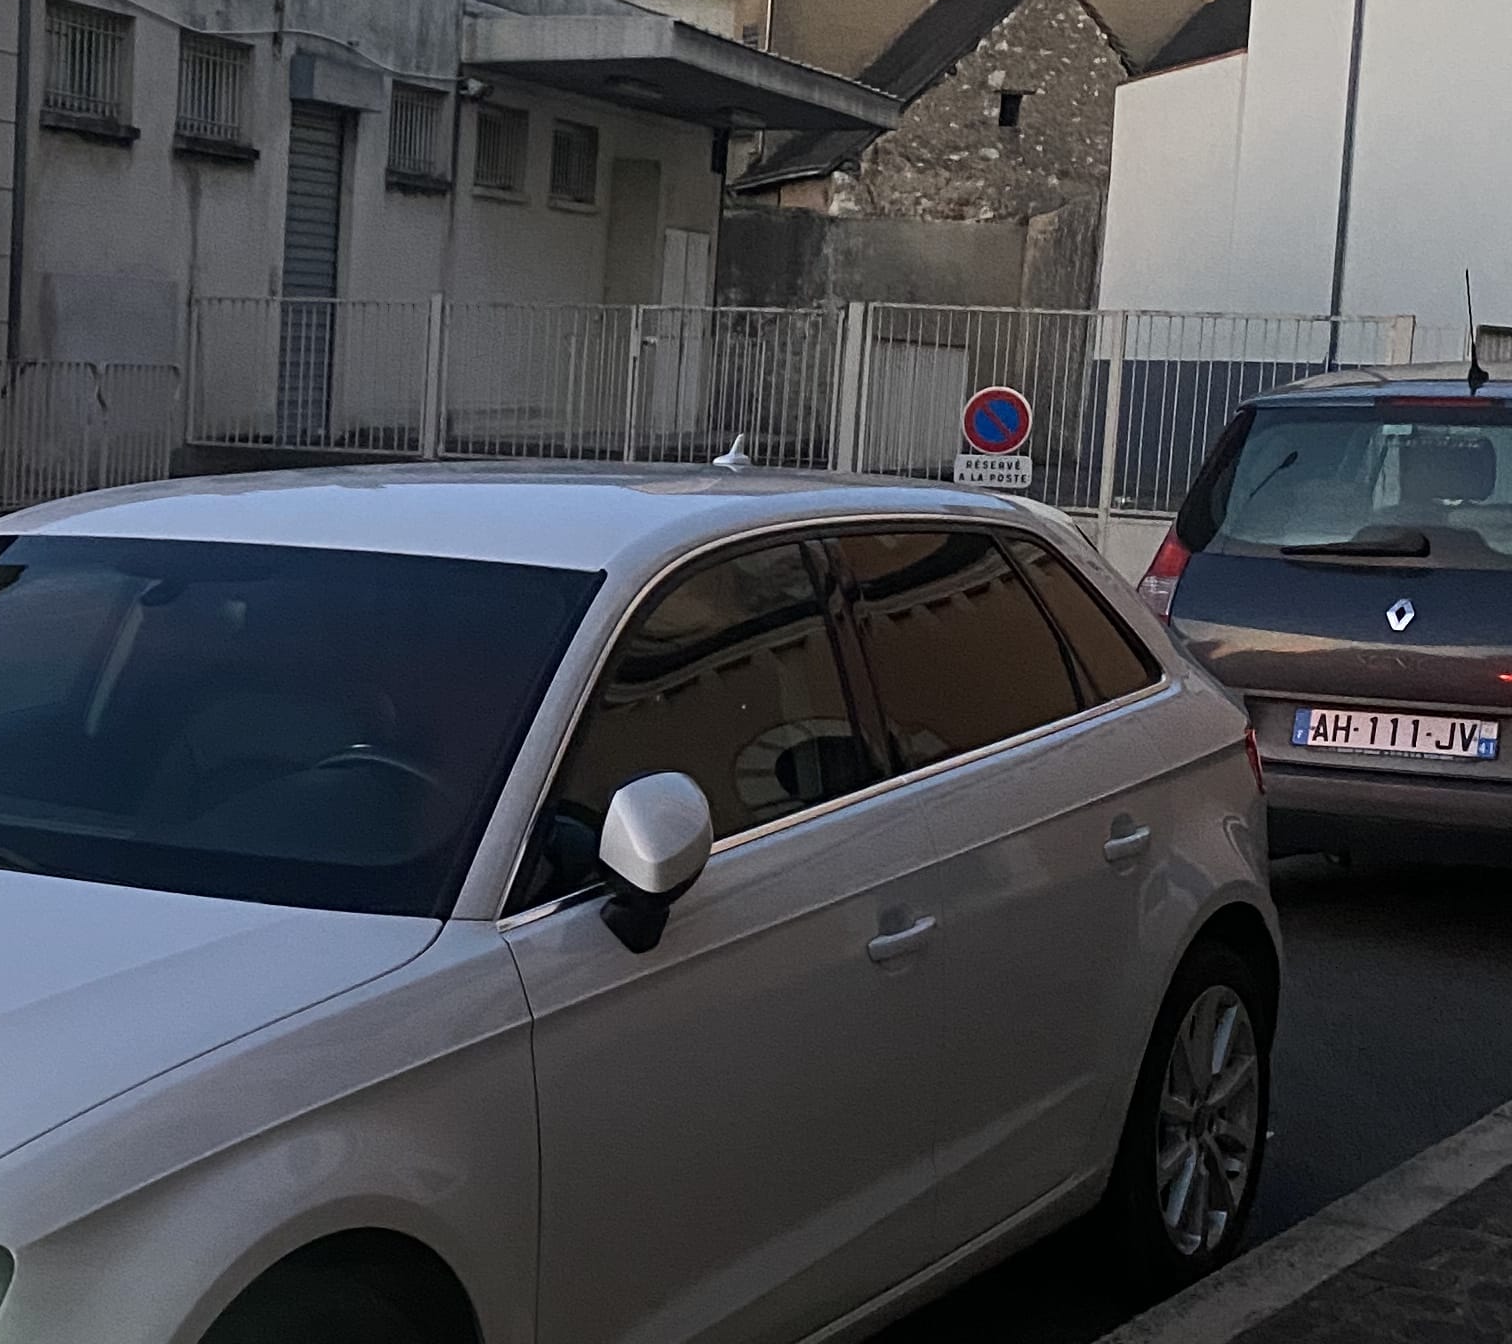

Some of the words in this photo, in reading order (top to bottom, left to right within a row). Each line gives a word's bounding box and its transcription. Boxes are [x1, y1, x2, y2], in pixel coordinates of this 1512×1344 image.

[966, 460, 1020, 470] RÉSERVÉ
[970, 473, 984, 482] LA
[989, 474, 1027, 483] POSTE
[1312, 713, 1477, 751] AH-111-JV
